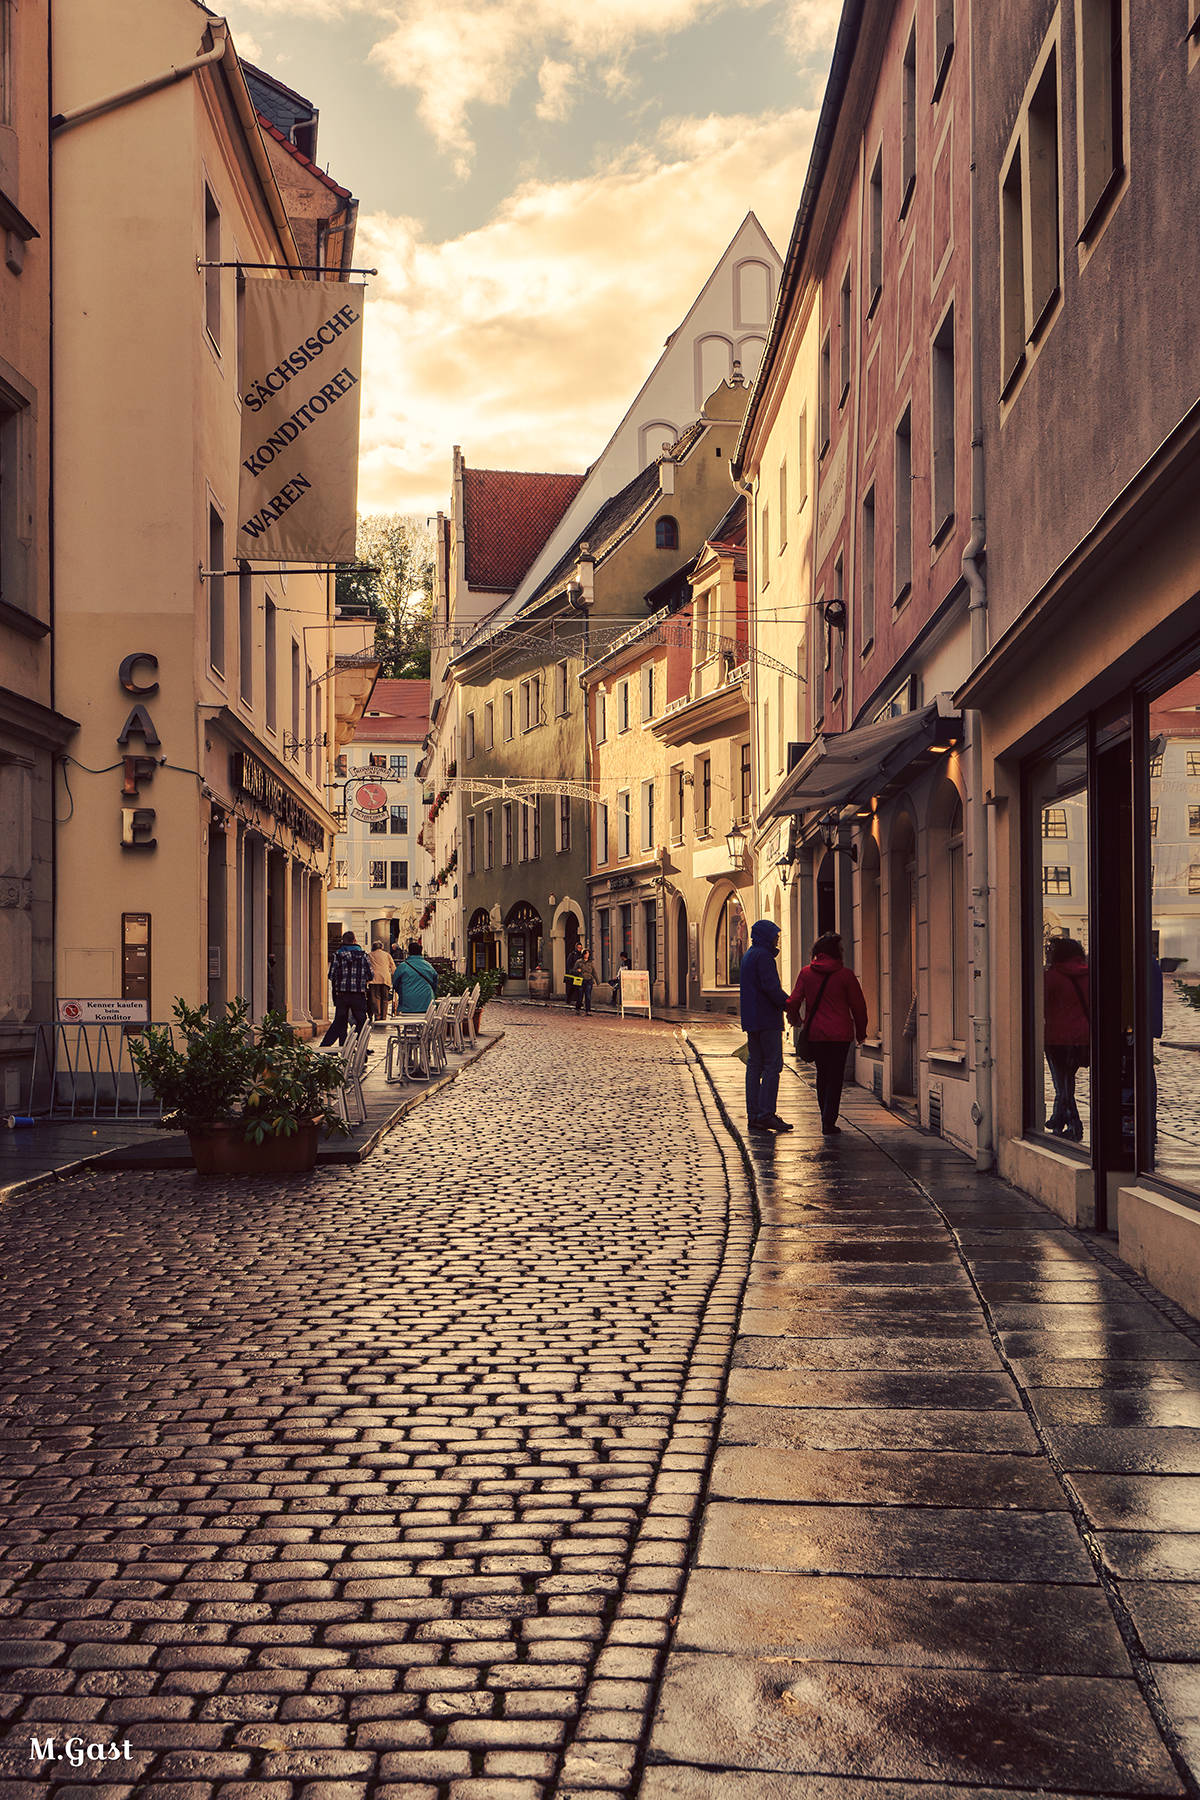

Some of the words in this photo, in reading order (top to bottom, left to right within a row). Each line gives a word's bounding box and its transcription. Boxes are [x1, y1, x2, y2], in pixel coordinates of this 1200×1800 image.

[244, 304, 360, 413] SÄCHSISCHE
[242, 367, 359, 478] KONDITOREI
[241, 472, 312, 539] WAREN
[117, 652, 161, 849] CAFE
